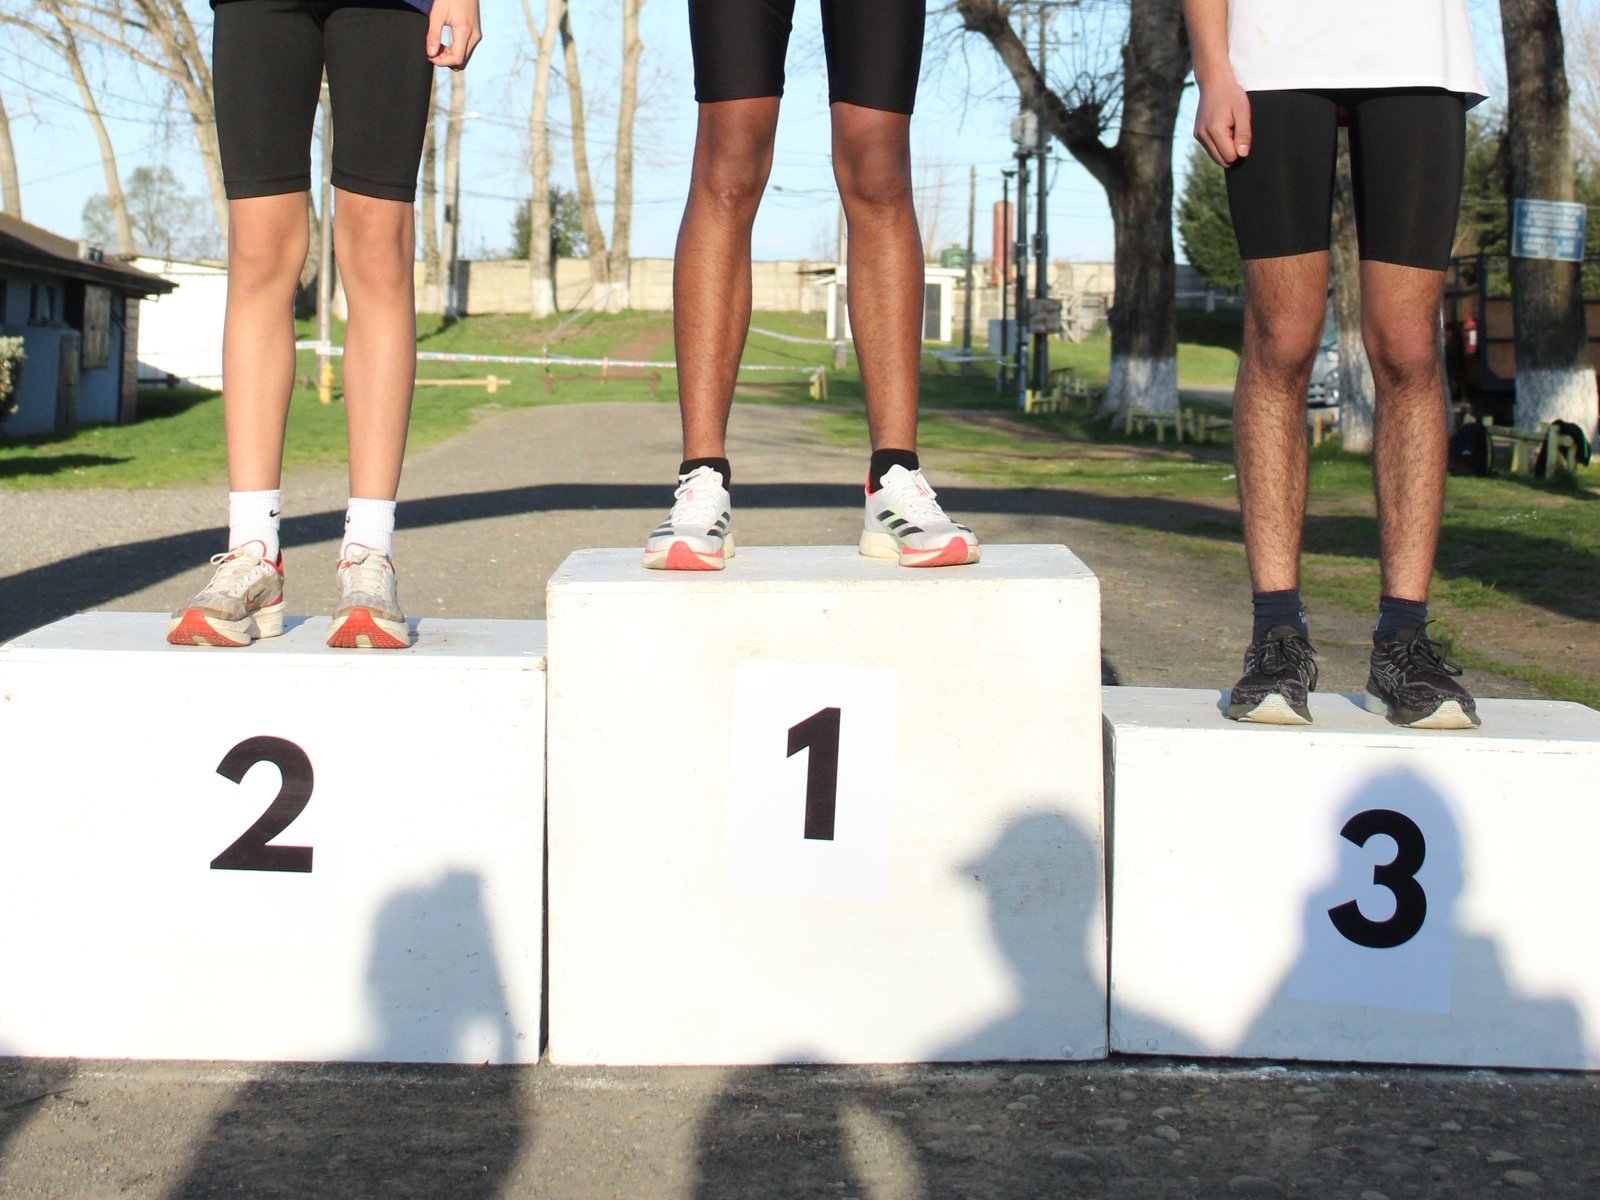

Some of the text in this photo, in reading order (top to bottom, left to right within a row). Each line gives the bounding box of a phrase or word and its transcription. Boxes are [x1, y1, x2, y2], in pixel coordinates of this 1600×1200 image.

[210, 736, 314, 873] 2
[786, 707, 841, 841] 1
[1328, 809, 1427, 949] 3
